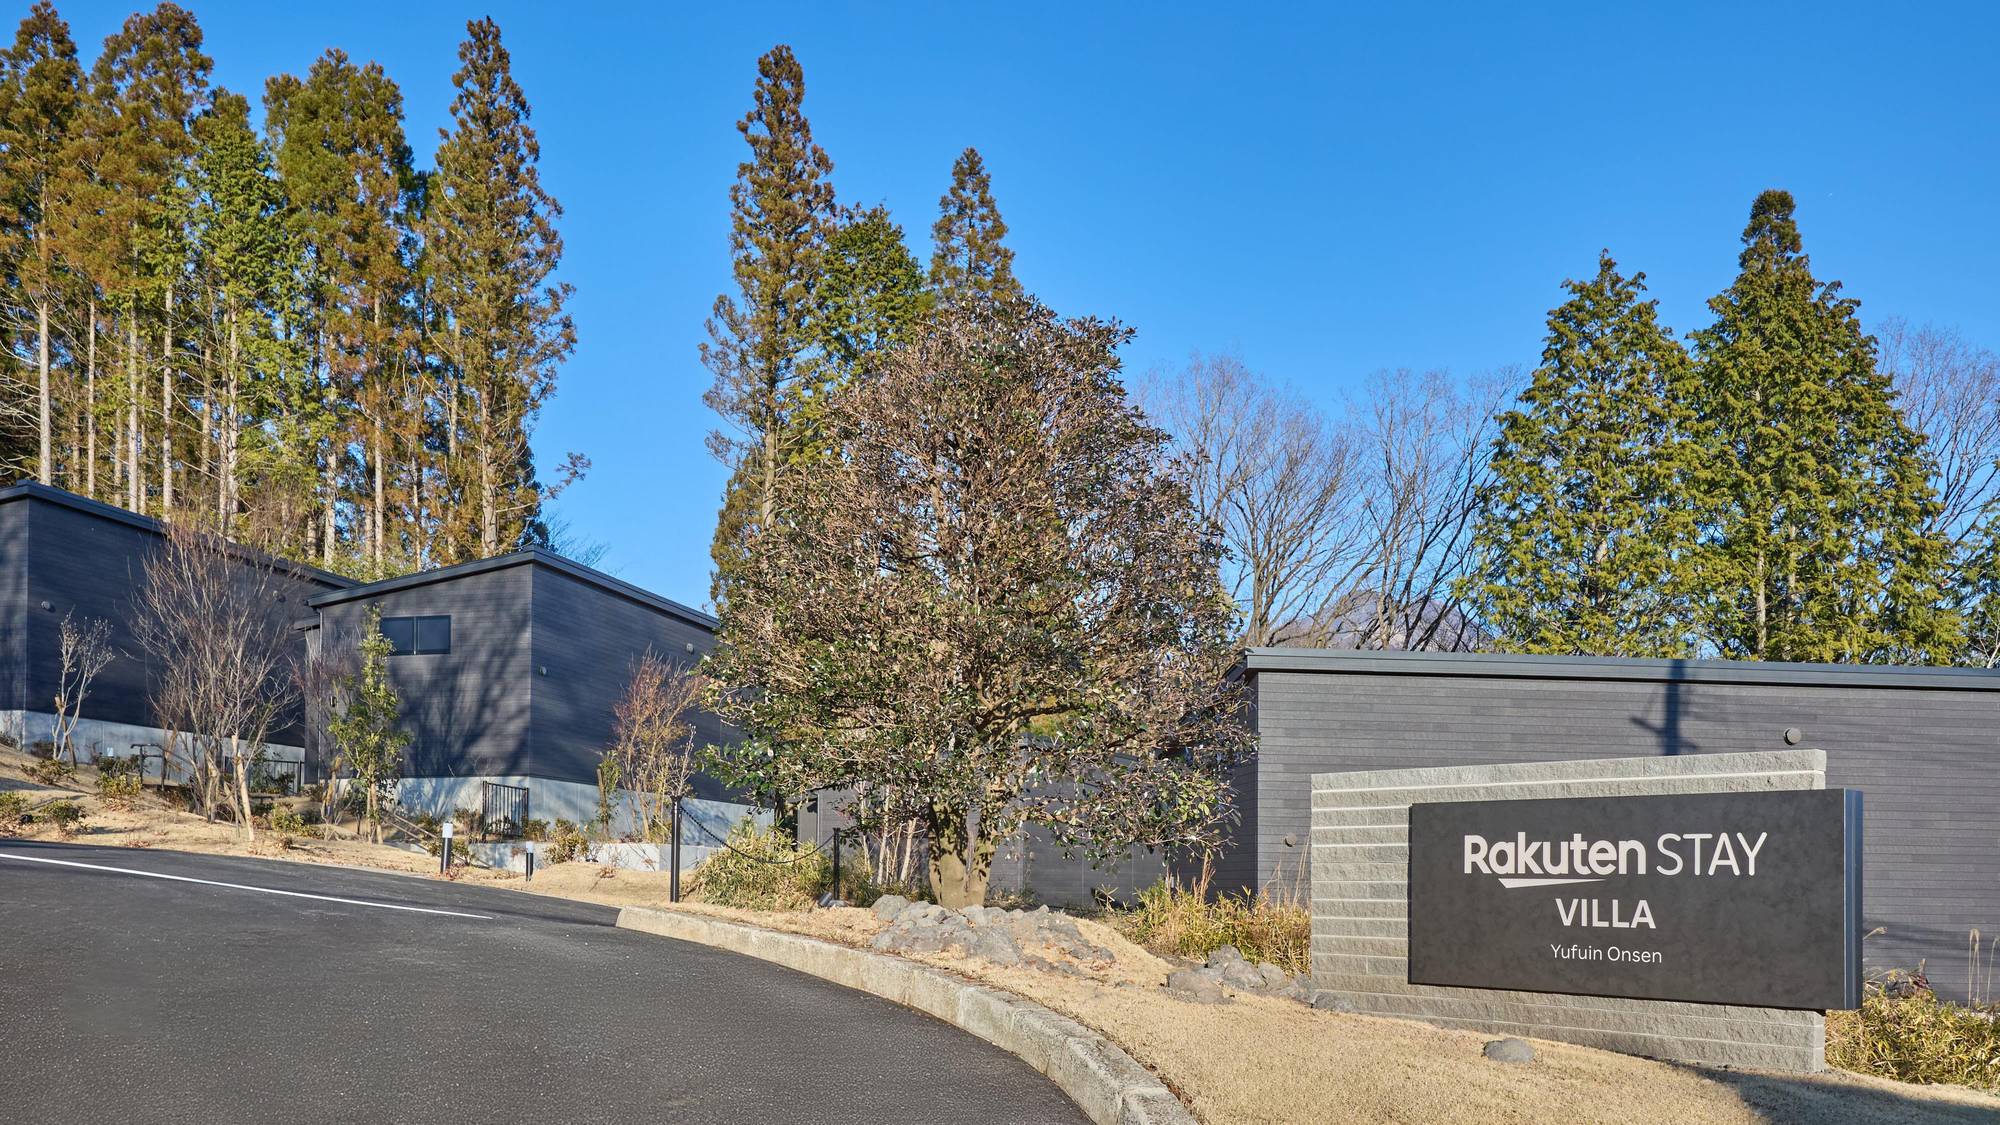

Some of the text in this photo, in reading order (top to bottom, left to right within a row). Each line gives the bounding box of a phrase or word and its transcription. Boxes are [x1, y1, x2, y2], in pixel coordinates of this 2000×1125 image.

[1463, 831, 1768, 877] Rakuten STAY
[1555, 898, 1657, 929] VILLA
[1550, 943, 1663, 964] Yufuin Onsen
